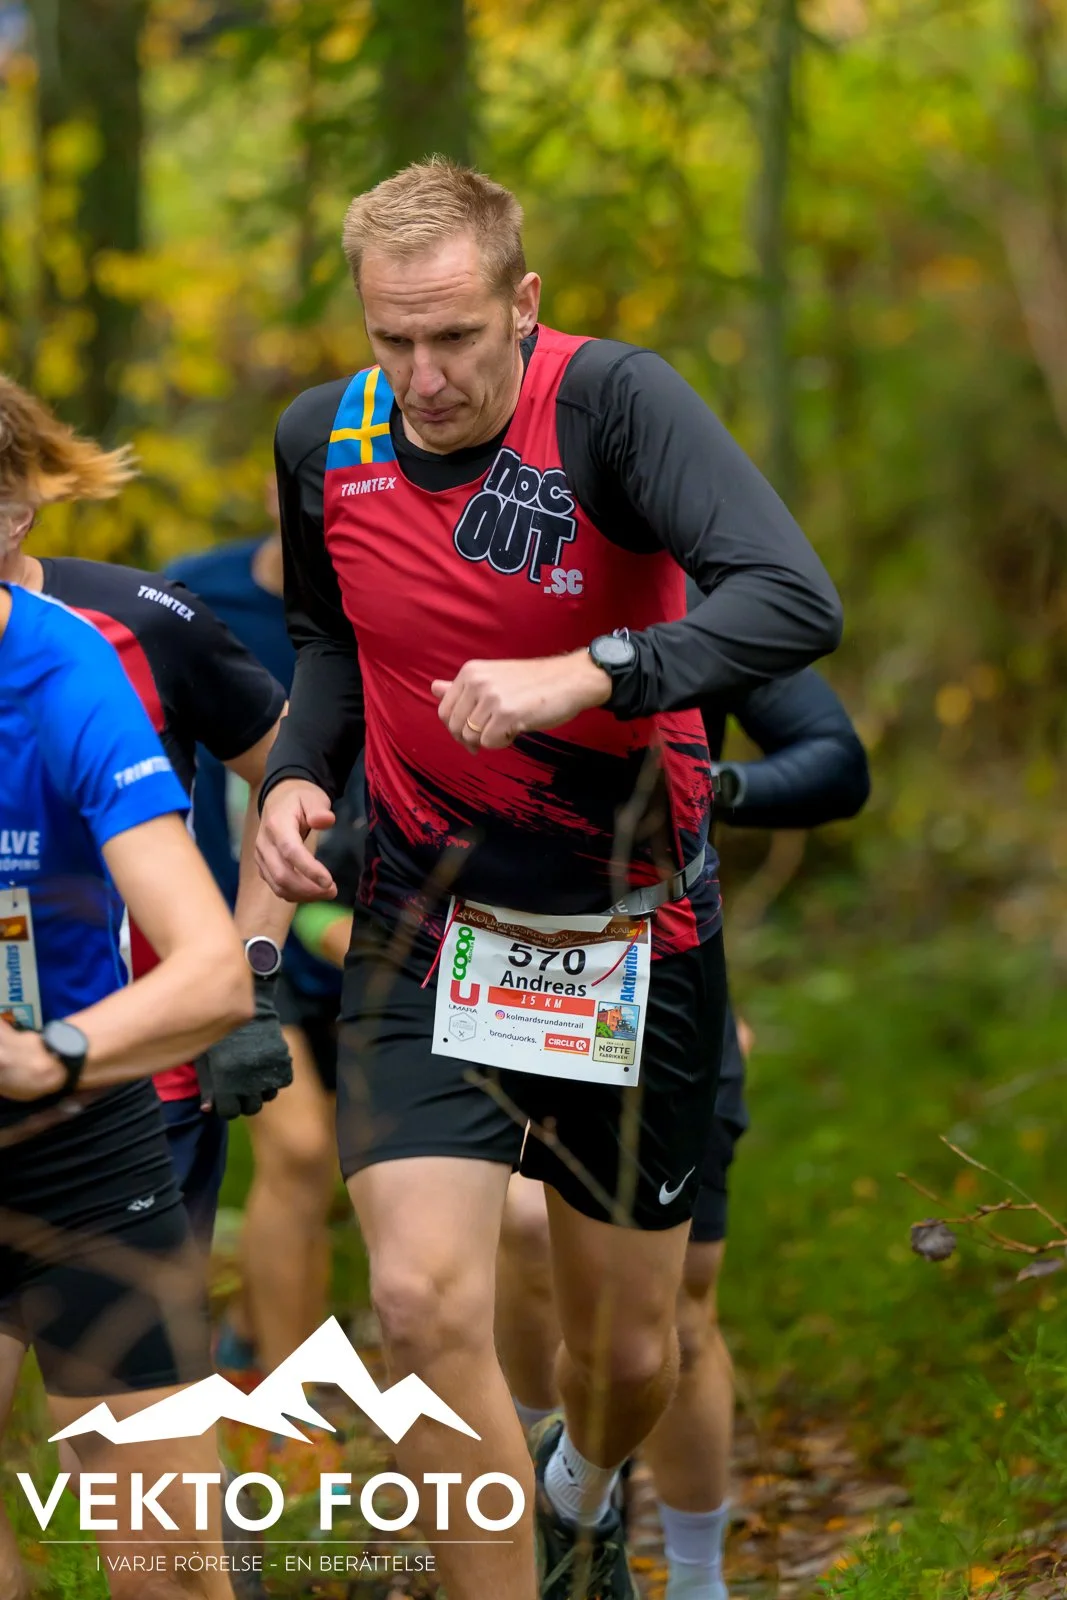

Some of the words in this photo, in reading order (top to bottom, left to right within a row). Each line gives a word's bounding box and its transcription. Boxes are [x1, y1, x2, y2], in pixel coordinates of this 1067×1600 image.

[341, 476, 397, 498] TRIMTEX
[453, 490, 579, 583] OUT
[137, 585, 196, 622] TRIMTEX
[453, 926, 474, 981] coop
[508, 942, 586, 976] 570
[500, 970, 587, 997] Andreas
[620, 945, 638, 1003] Aktivitus
[521, 994, 536, 1006] 15
[545, 998, 562, 1009] KM
[506, 1013, 584, 1030] kolmardsrundantrail
[548, 1038, 575, 1048] CIRCLE
[599, 1045, 631, 1055] NØTTE
